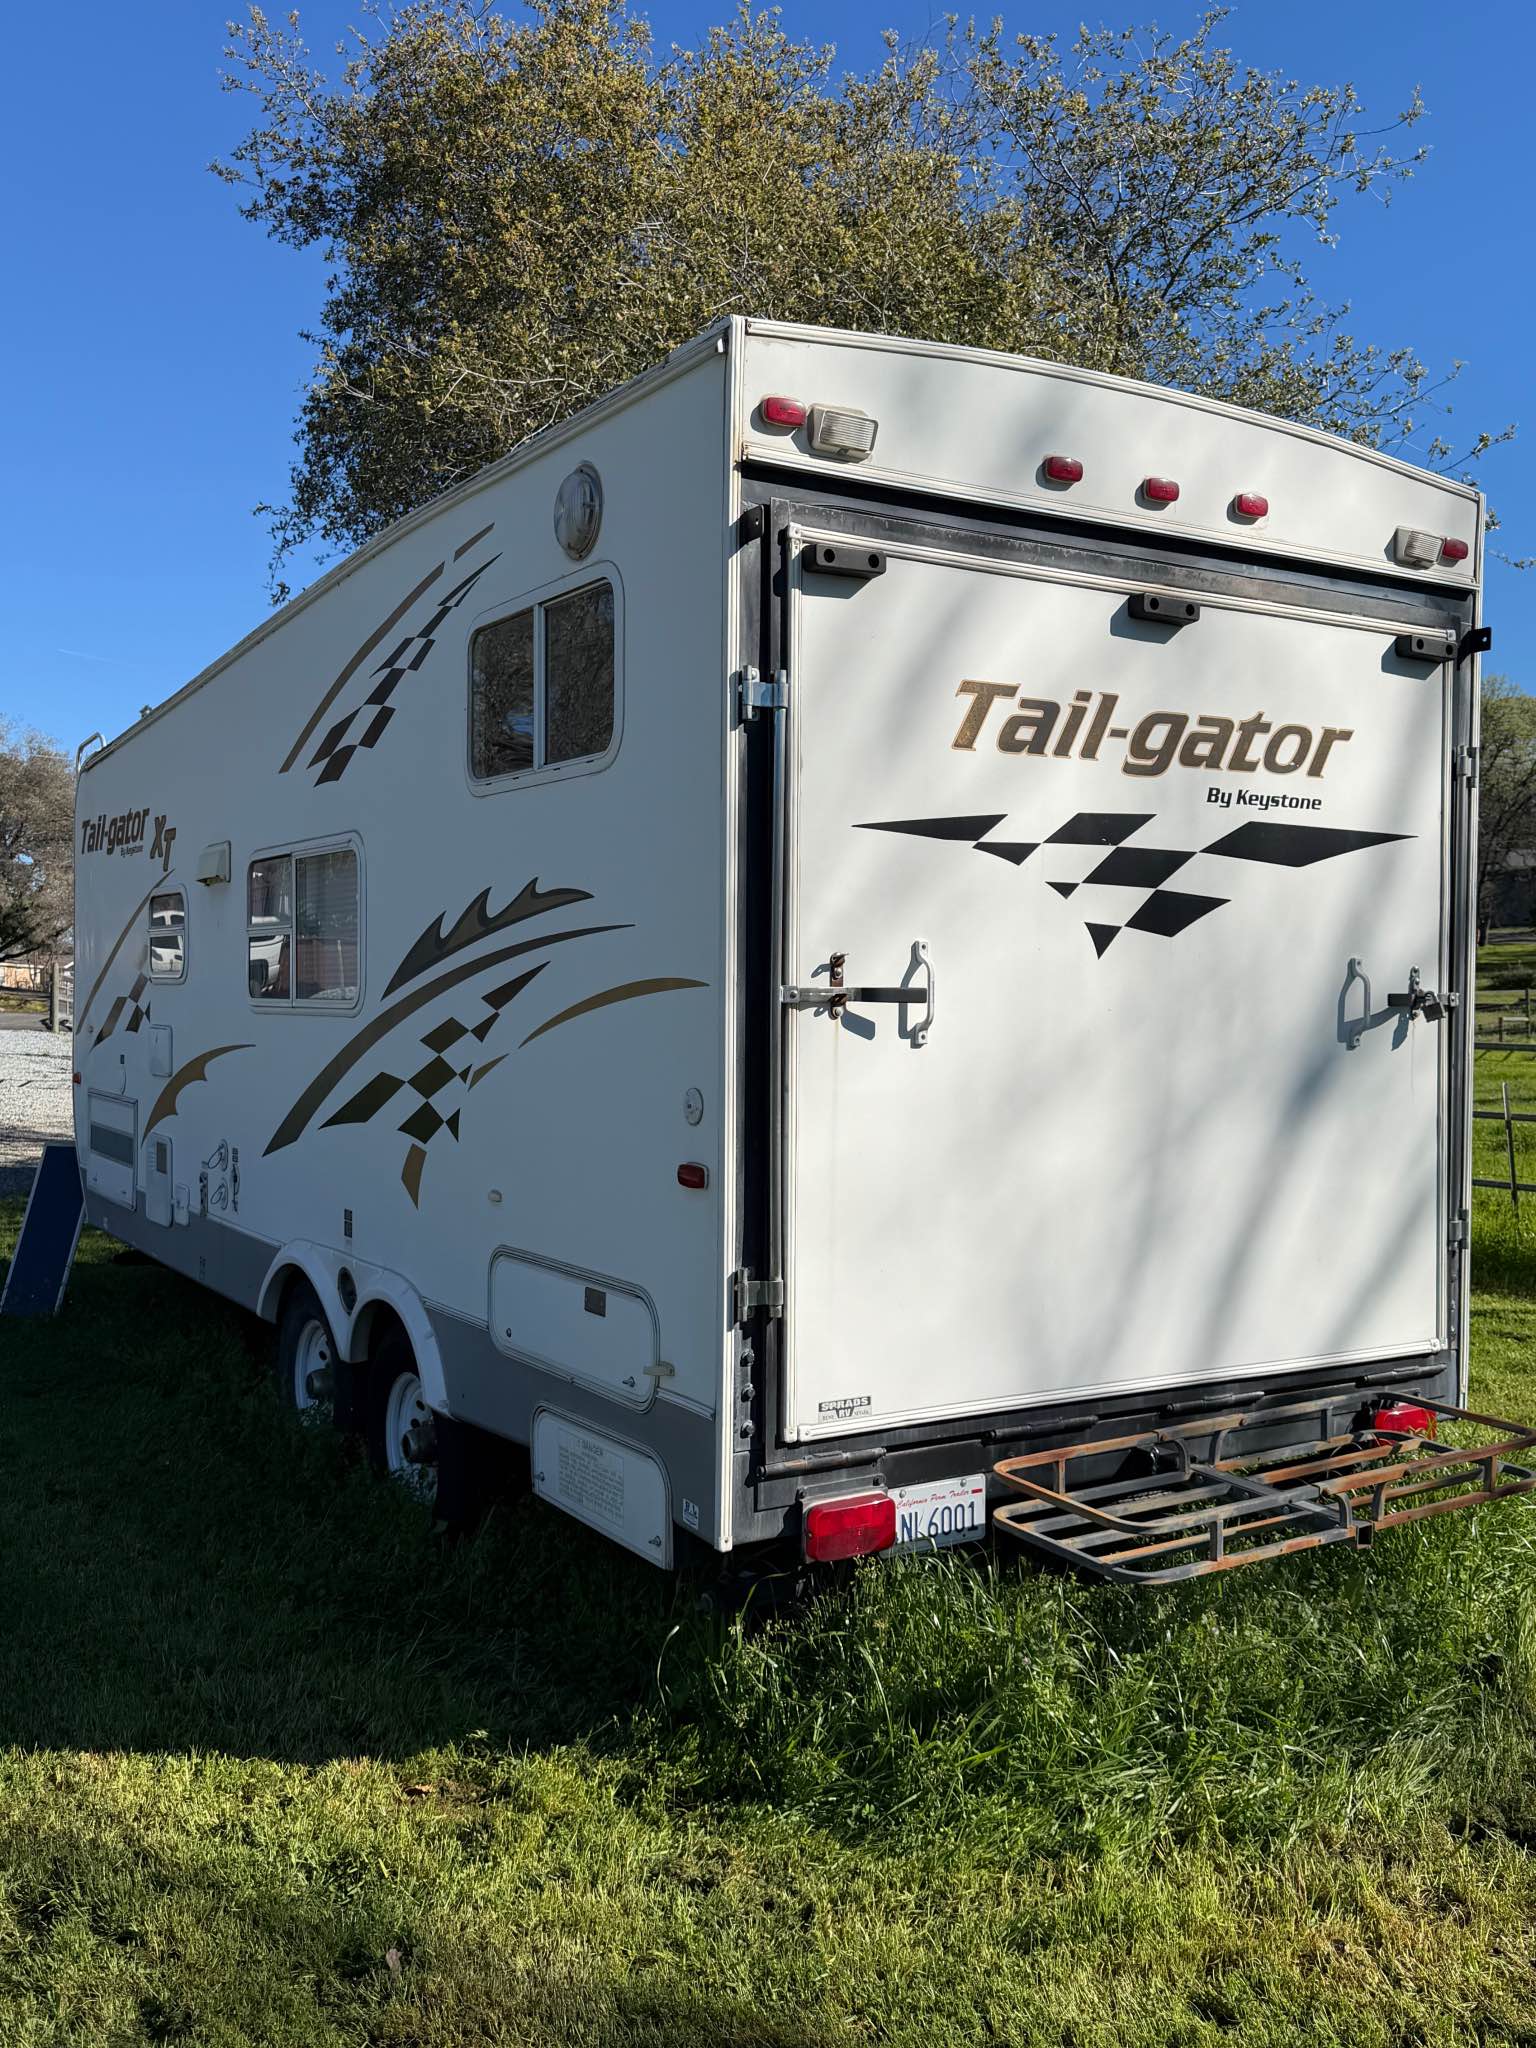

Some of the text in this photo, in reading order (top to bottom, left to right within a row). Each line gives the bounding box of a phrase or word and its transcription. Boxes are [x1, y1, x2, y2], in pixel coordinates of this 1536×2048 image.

[951, 679, 1354, 778] Tail-gator
[1206, 787, 1322, 810] By Keystone
[81, 808, 177, 872] Tail-gator XT
[821, 1397, 868, 1411] SPRADS
[838, 1408, 852, 1418] RV
[896, 1498, 928, 1509] California
[949, 1489, 970, 1498] Trailer
[896, 1501, 979, 1543] NK6001
